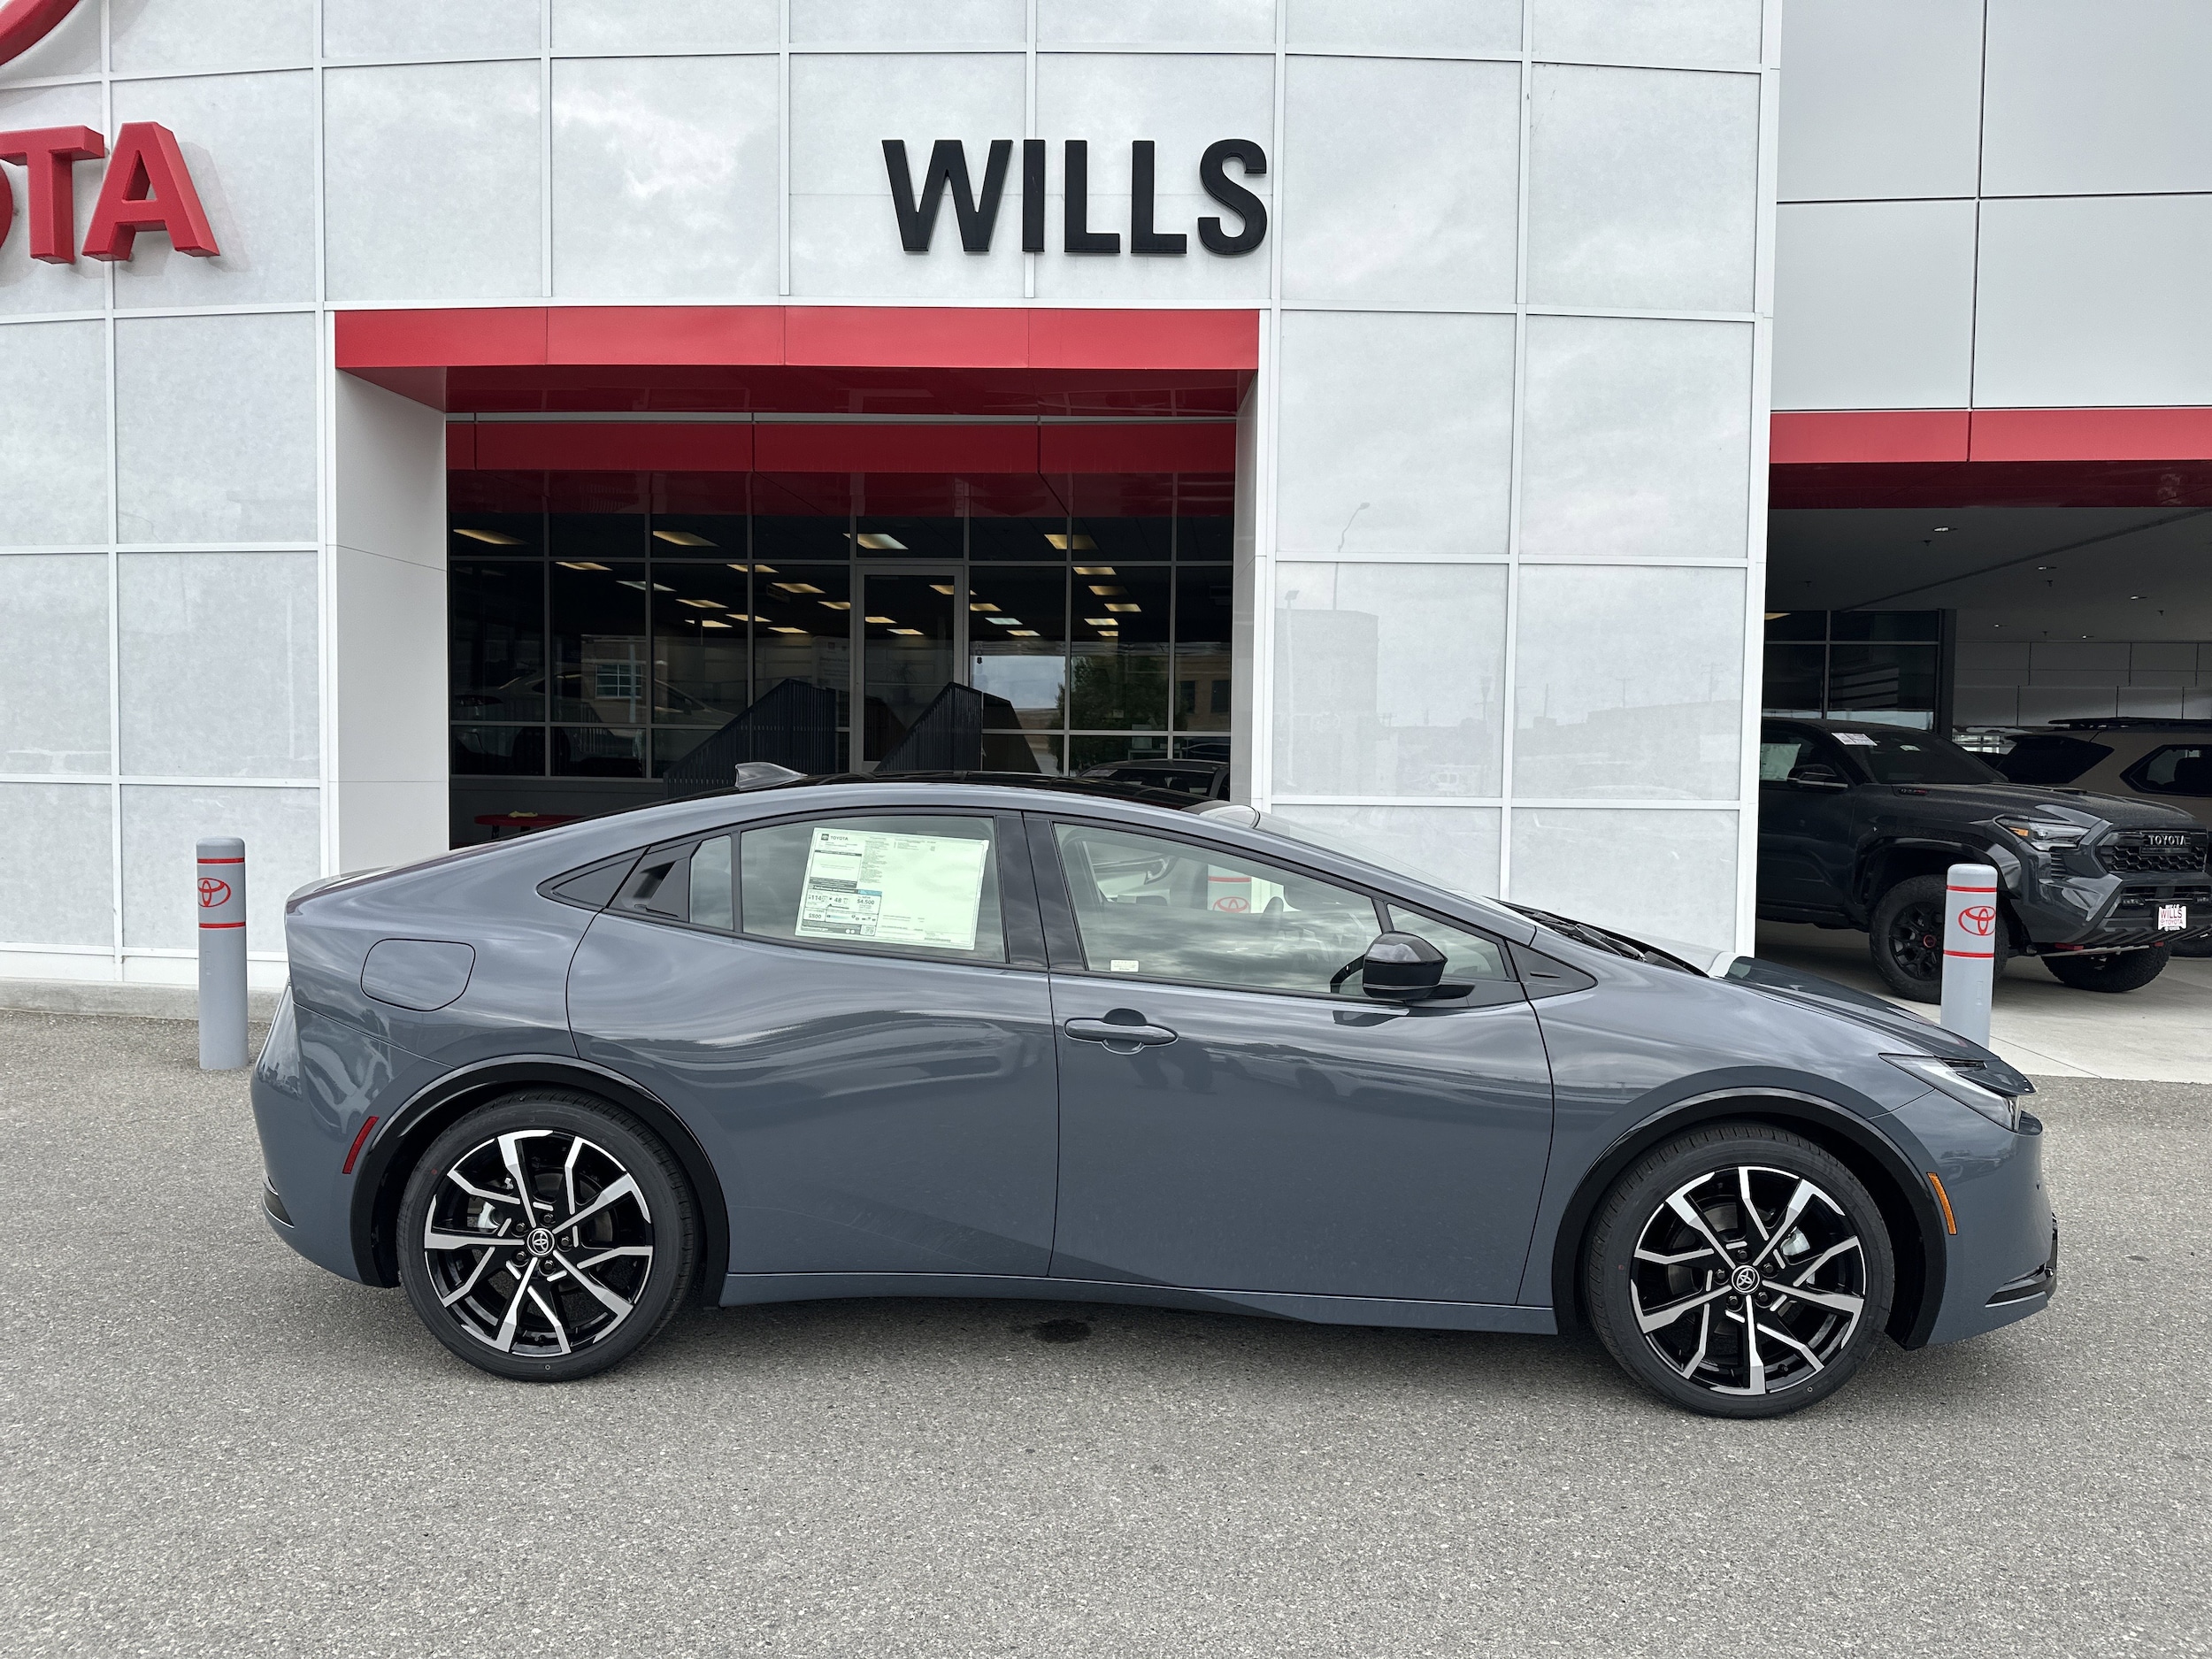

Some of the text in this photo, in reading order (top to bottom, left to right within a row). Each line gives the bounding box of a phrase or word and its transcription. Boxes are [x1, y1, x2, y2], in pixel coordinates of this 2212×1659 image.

[0, 121, 220, 264] TA
[881, 138, 1268, 256] WILLS
[2148, 835, 2186, 846] TOYOTA
[2160, 909, 2183, 919] WILLS
